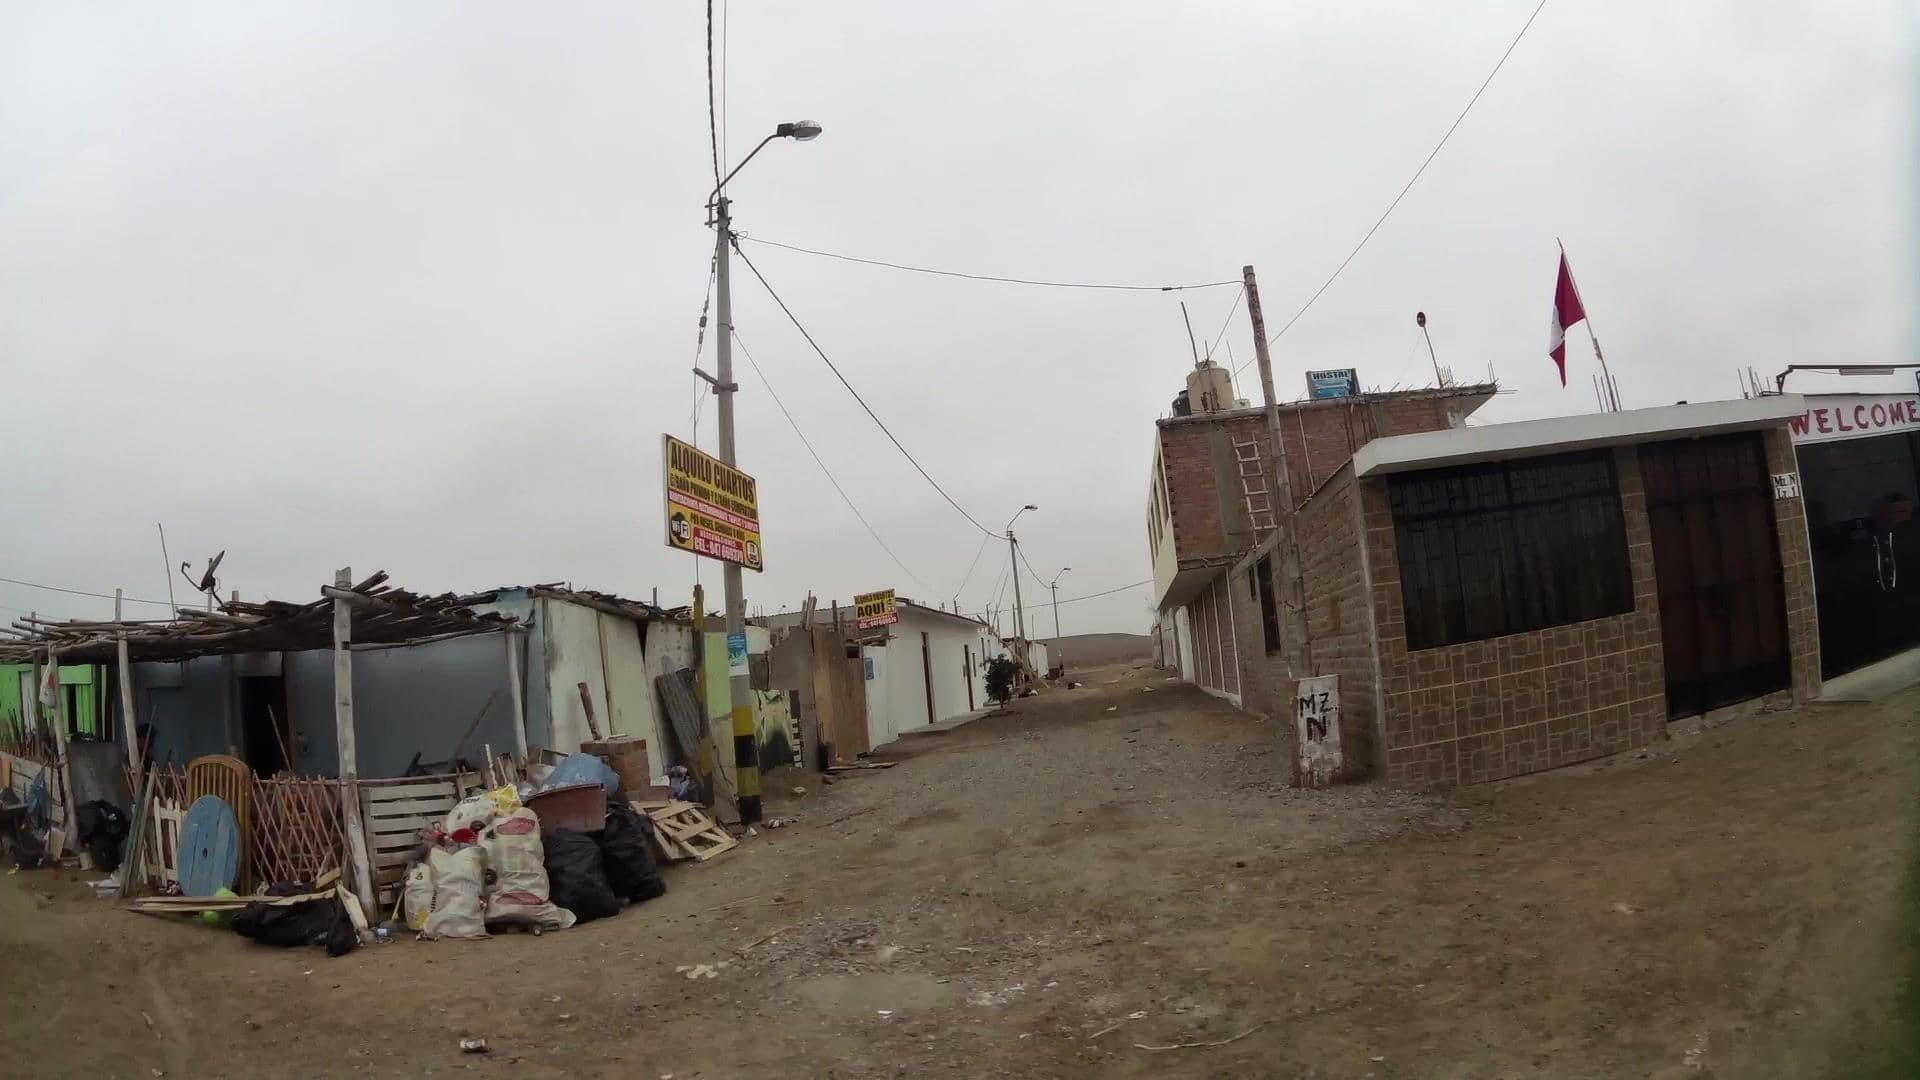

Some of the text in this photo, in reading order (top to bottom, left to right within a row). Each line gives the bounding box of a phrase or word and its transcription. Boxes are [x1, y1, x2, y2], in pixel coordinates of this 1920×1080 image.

[1791, 400, 1920, 435] WELCOME
[671, 442, 754, 504] ALQUILO CUARTOS
[1307, 716, 1327, 741] N
